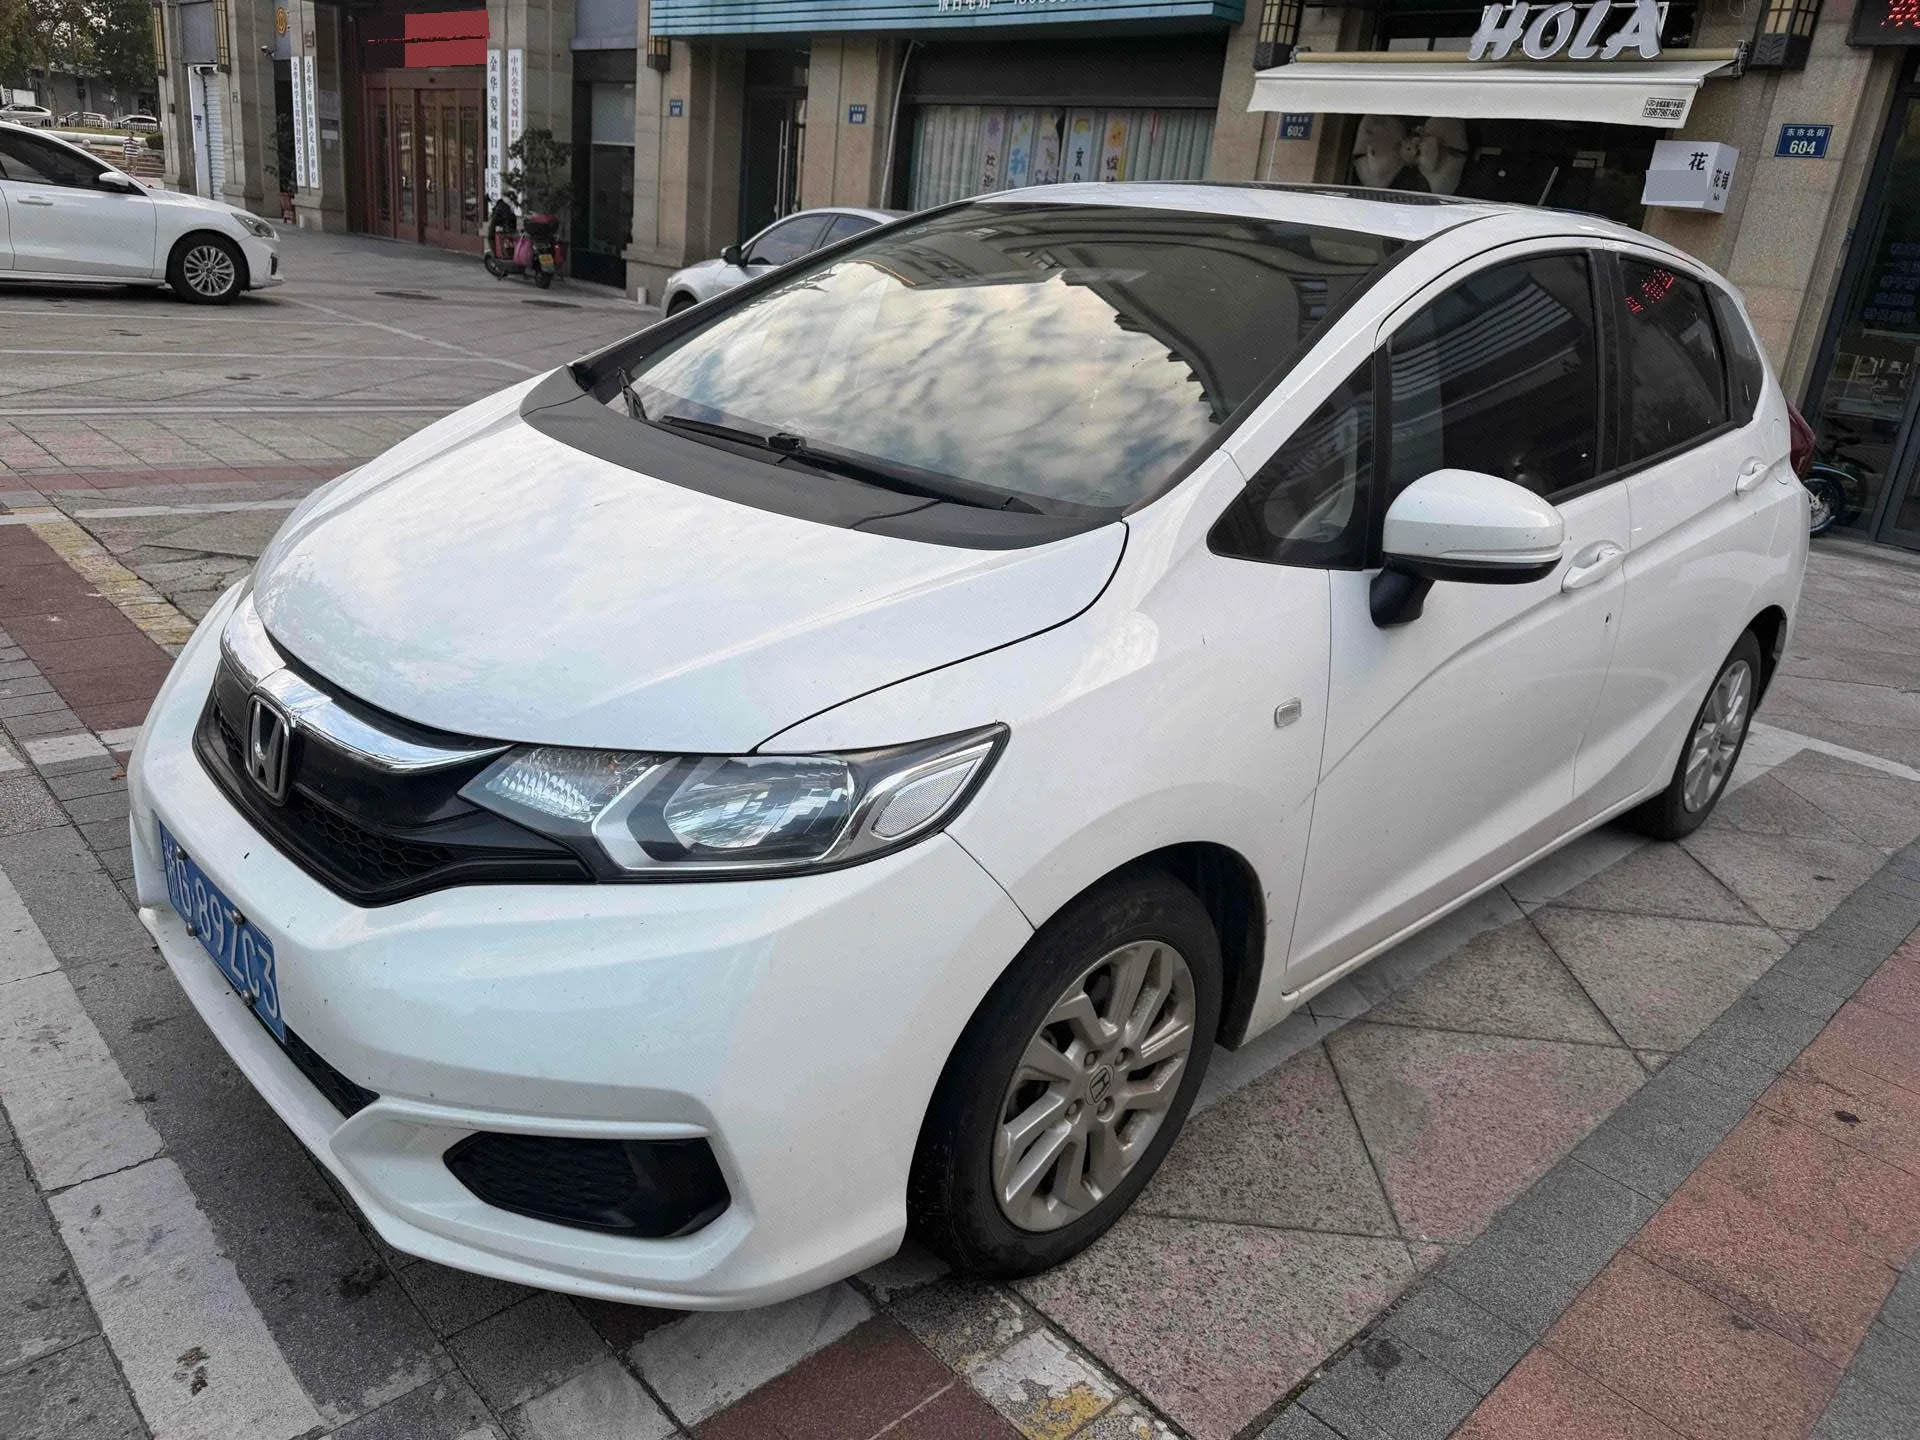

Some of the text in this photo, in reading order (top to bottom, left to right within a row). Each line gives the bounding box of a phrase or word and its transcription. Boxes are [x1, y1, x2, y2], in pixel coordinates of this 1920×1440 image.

[1466, 0, 1661, 61] HOLA
[1286, 125, 1304, 137] 602
[1786, 128, 1826, 137] 东市北街
[1789, 140, 1817, 154] 604
[1688, 152, 1709, 170] 花
